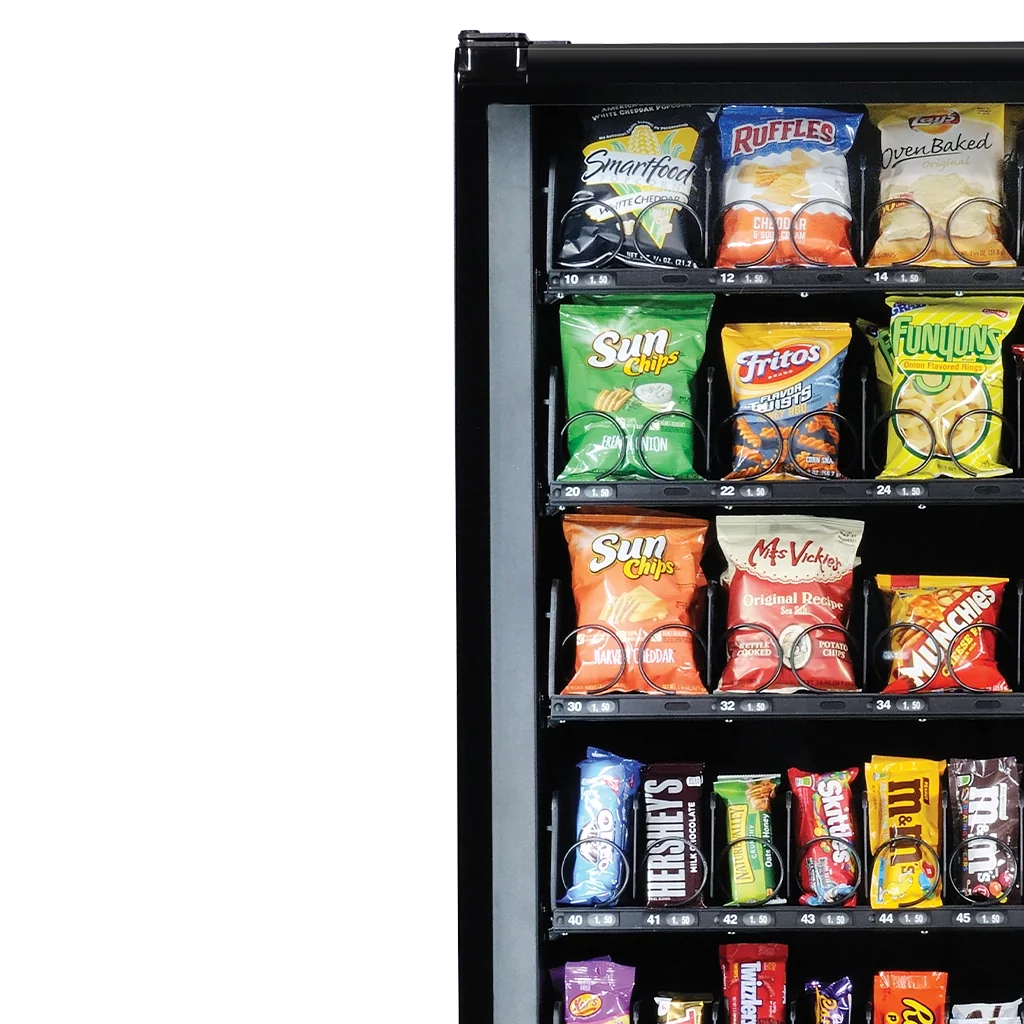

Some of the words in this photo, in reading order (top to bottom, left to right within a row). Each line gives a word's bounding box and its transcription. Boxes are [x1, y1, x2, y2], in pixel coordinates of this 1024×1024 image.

[592, 112, 617, 121] WHITE
[732, 118, 835, 155] RUFFLES
[882, 145, 931, 170] Oven
[931, 133, 993, 154] Baked
[583, 149, 696, 184] Smartfood
[600, 196, 633, 215] WHITE
[634, 195, 681, 205] CHEDDAR
[564, 274, 579, 285] 10
[720, 273, 735, 283] 12
[874, 272, 889, 282] 14
[587, 329, 669, 368] Sun
[623, 350, 680, 377] Chips
[736, 345, 821, 383] Fritos
[904, 361, 925, 369] Onion
[927, 362, 959, 371] Flavored
[961, 363, 983, 372] Rings
[767, 369, 794, 380] BRAND
[760, 382, 802, 402] FLAVOR
[788, 404, 808, 417] BBQ
[565, 487, 581, 497] 20
[720, 486, 736, 496] 22
[876, 485, 892, 495] 24
[589, 534, 667, 573] Sun
[790, 541, 842, 573] Vickie's
[623, 556, 676, 581] Chips
[743, 593, 797, 612] Original
[802, 592, 844, 616] Recipe
[780, 606, 793, 615] Sea
[819, 641, 849, 652] POTATO
[737, 648, 772, 657] COOKED
[823, 648, 846, 659] CHIPS
[567, 702, 582, 712] 30
[720, 701, 735, 711] 32
[876, 700, 892, 710] 34
[762, 813, 770, 839] Honey
[817, 780, 855, 864] Skittles
[644, 779, 686, 897] HERSHEY'S
[689, 853, 698, 874] MILK
[765, 849, 773, 868] Oats
[568, 915, 583, 925] 40
[647, 915, 661, 925] 41
[723, 914, 738, 925] 42
[801, 914, 816, 925] 43
[879, 913, 894, 924] 44
[956, 913, 971, 923] 45
